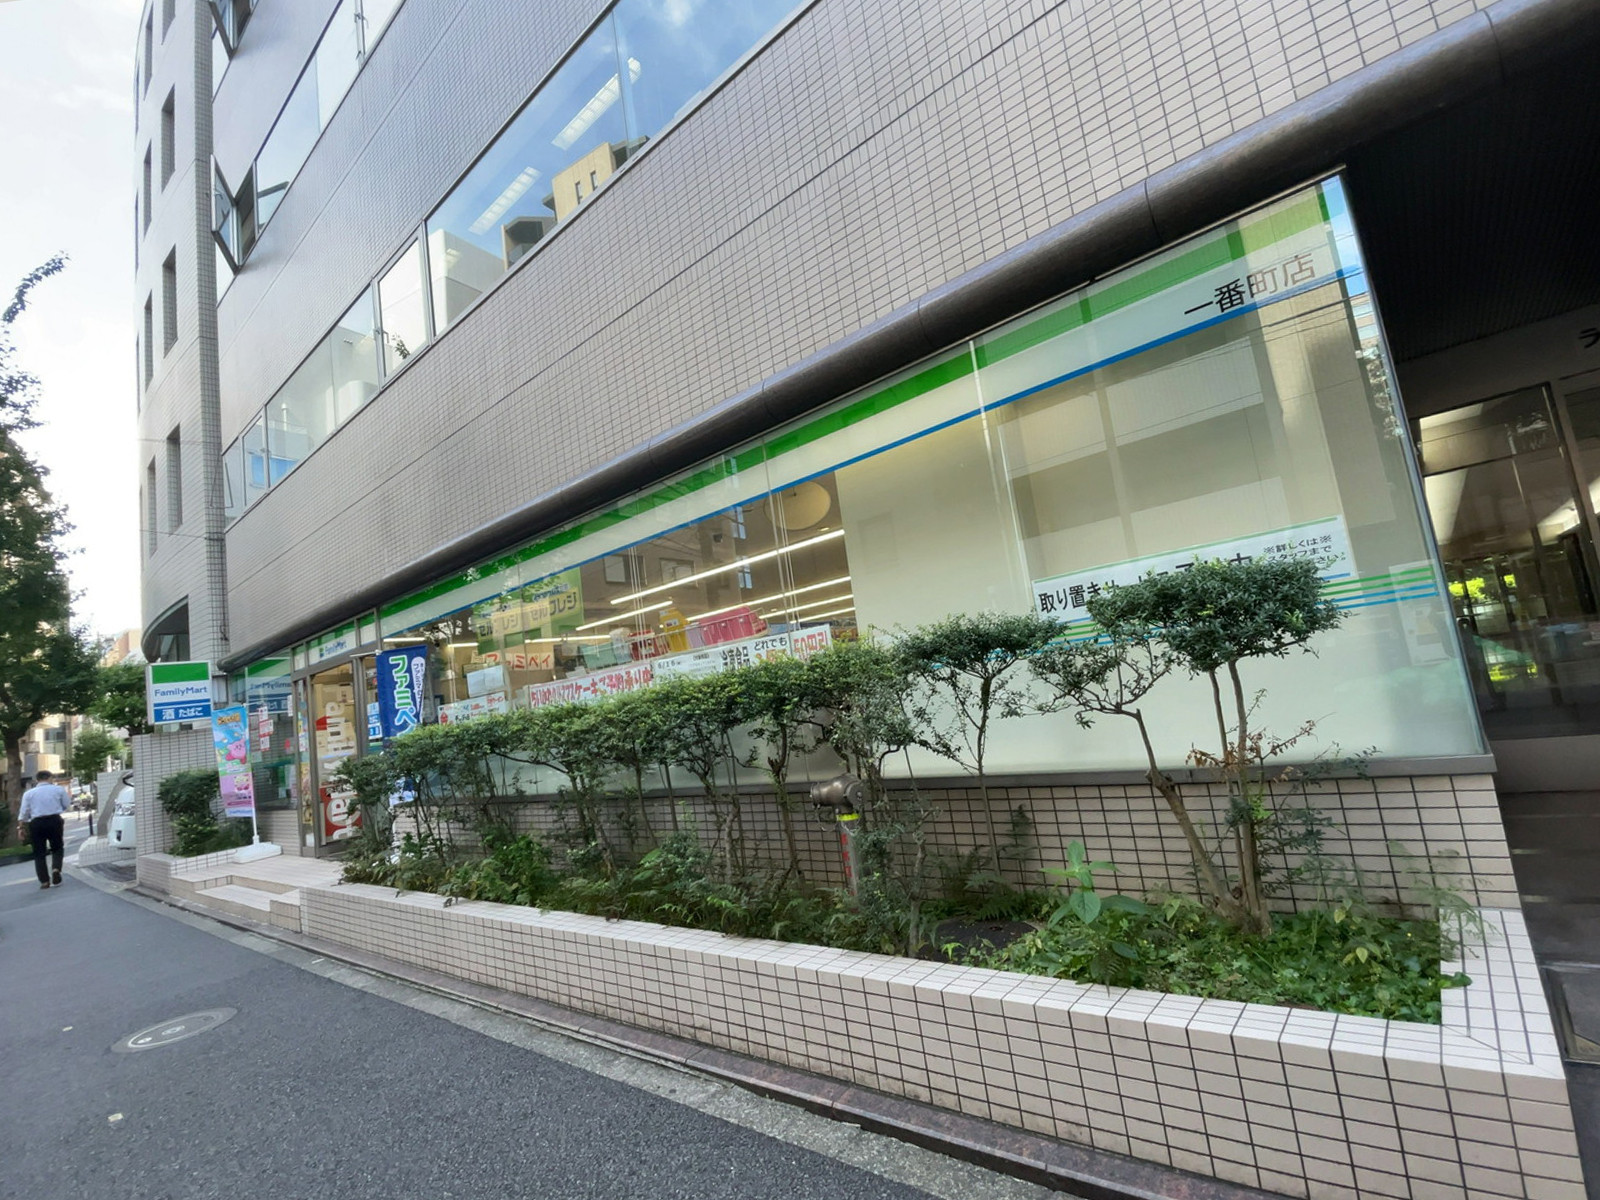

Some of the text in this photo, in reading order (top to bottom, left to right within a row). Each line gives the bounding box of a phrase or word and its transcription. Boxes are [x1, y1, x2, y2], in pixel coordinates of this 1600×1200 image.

[1183, 252, 1316, 315] 一番町店
[479, 611, 519, 637] セルレジ
[754, 636, 788, 651] どれでも
[154, 686, 208, 697] FamilyMart
[162, 707, 203, 720] 酒 たばこ
